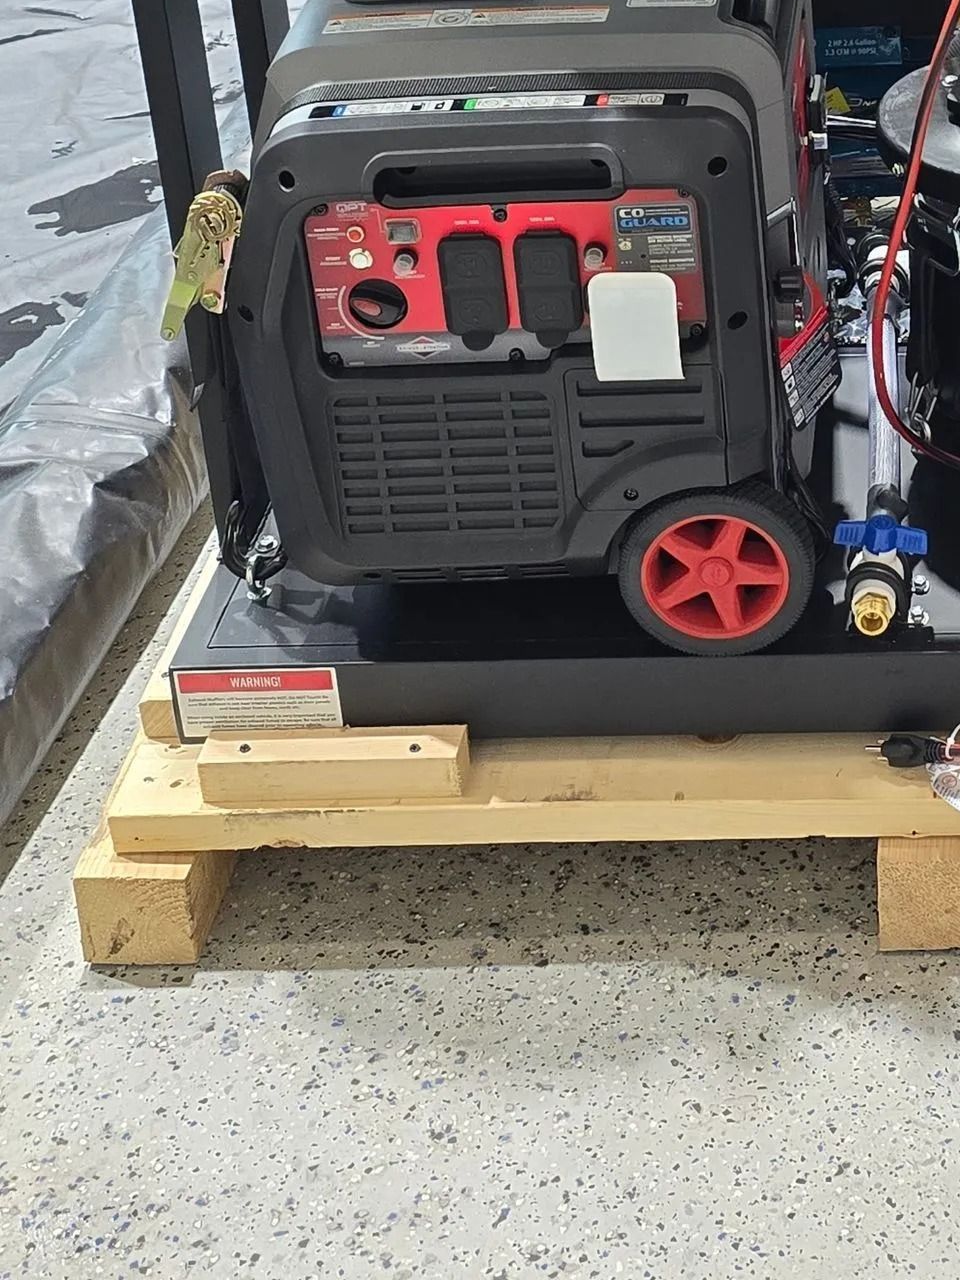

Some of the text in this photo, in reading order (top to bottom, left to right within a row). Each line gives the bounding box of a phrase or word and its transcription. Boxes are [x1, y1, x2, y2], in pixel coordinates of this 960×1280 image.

[618, 208, 645, 218] CO
[619, 216, 689, 228] GUARD
[229, 676, 281, 688] WARNING!
